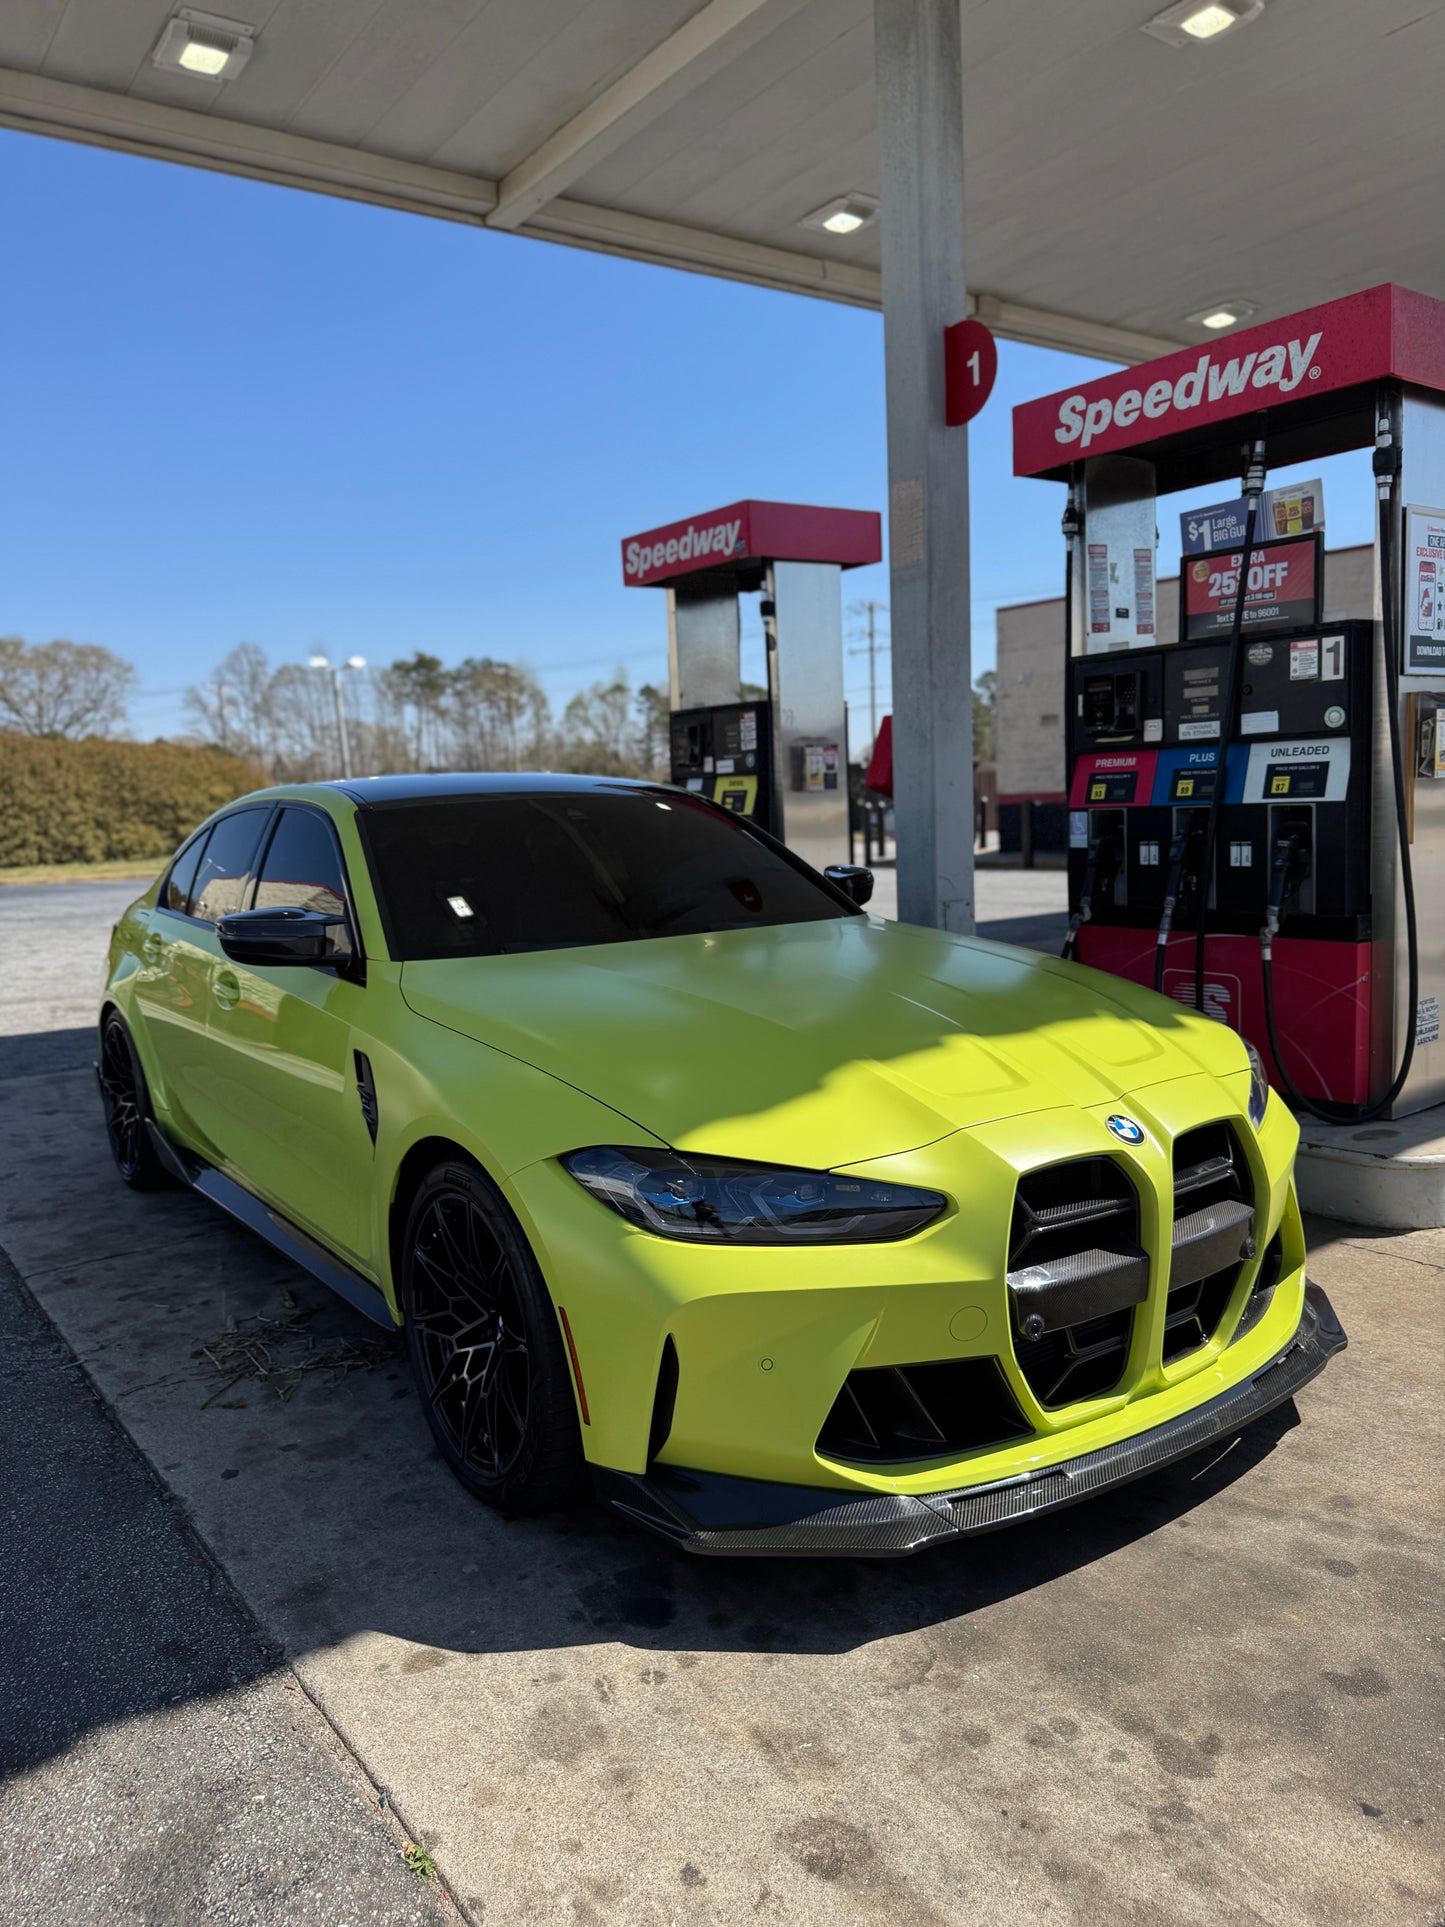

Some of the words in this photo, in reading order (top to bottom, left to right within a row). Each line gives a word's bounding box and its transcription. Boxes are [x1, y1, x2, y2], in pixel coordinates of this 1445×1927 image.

[966, 350, 980, 387] 1
[1211, 514, 1237, 530] Large
[1187, 519, 1212, 551] $1
[1213, 528, 1229, 543] BIG
[625, 519, 742, 579] Speedway
[1231, 550, 1265, 567] EXRA
[1247, 562, 1288, 591] OFF
[1216, 614, 1229, 623] Text
[1249, 610, 1257, 619] to
[1326, 640, 1341, 676] 1
[1416, 645, 1441, 657] DOWNLOAD
[1189, 752, 1216, 763] PLUS
[1270, 745, 1330, 757] UNLEADED
[1095, 757, 1137, 768] PREMIUM
[1274, 783, 1286, 792] 87
